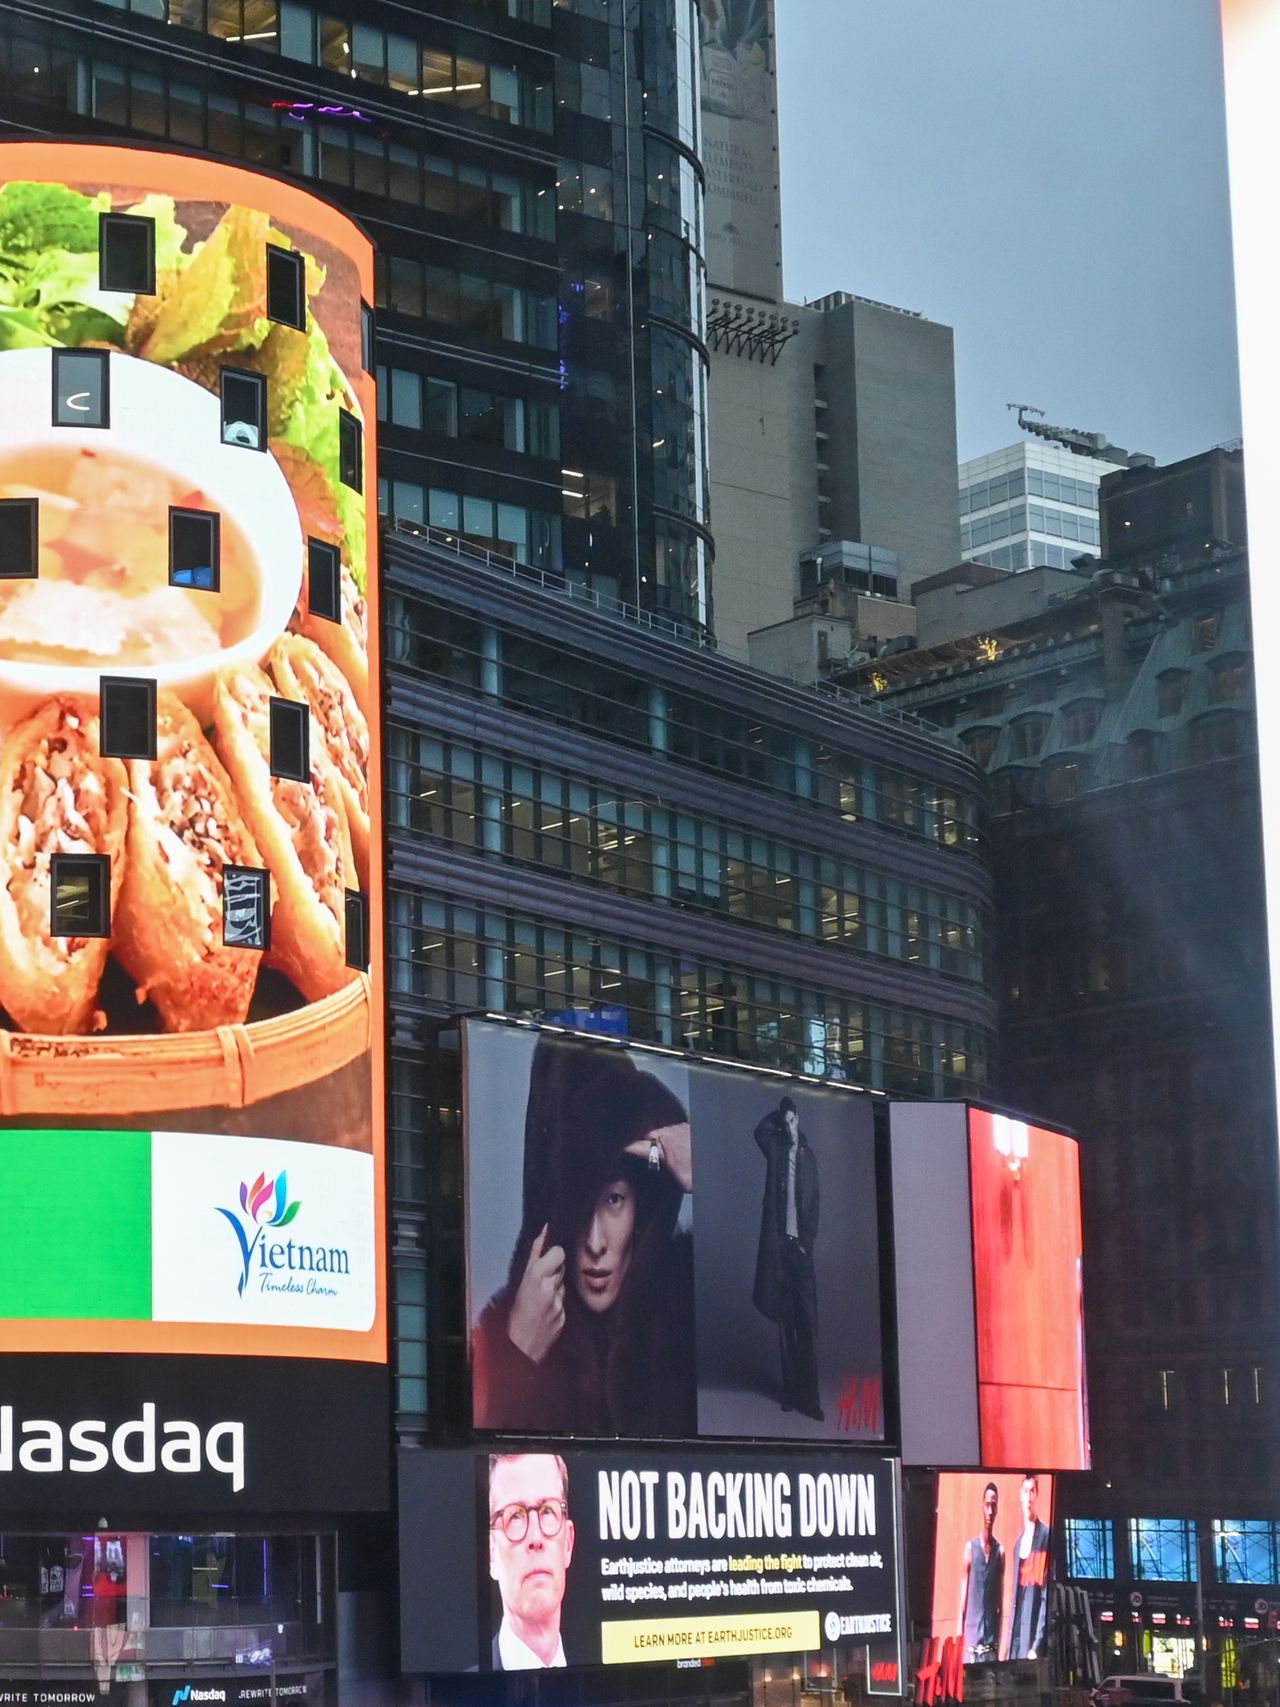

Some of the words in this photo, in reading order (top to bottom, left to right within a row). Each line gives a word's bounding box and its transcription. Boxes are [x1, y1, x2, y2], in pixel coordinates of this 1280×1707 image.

[705, 167, 764, 193] ASTERFULLY
[706, 182, 759, 206] OMBINED
[213, 1207, 350, 1299] Vietnam
[258, 1272, 304, 1293] Timeless
[306, 1277, 338, 1296] Charm
[598, 1470, 659, 1540] NOT
[667, 1471, 792, 1539] BACKING
[798, 1473, 876, 1537] DOWN
[601, 1557, 663, 1578] Earthjustice
[664, 1557, 711, 1576] attorneys
[711, 1558, 728, 1572] are
[728, 1554, 763, 1574] leading
[764, 1553, 780, 1571] the
[780, 1553, 802, 1573] fight
[803, 1553, 812, 1569] to
[813, 1553, 845, 1572] protect
[846, 1551, 869, 1568] clean
[869, 1551, 883, 1569] air,
[601, 1583, 624, 1601] wild
[625, 1582, 667, 1603] species,
[668, 1581, 687, 1598] and
[729, 1578, 760, 1596] health
[760, 1578, 783, 1595] from
[783, 1577, 806, 1593] toxic
[806, 1575, 854, 1593] chemicals.
[634, 1633, 665, 1648] LEARN
[667, 1632, 693, 1646] MORE
[695, 1631, 706, 1645] AT
[708, 1626, 793, 1644] EARTHJUSTICE.ORG
[33, 1692, 96, 1703] TOMORROW
[190, 1688, 226, 1703] Nasdaq
[241, 1687, 272, 1699] REWRITE
